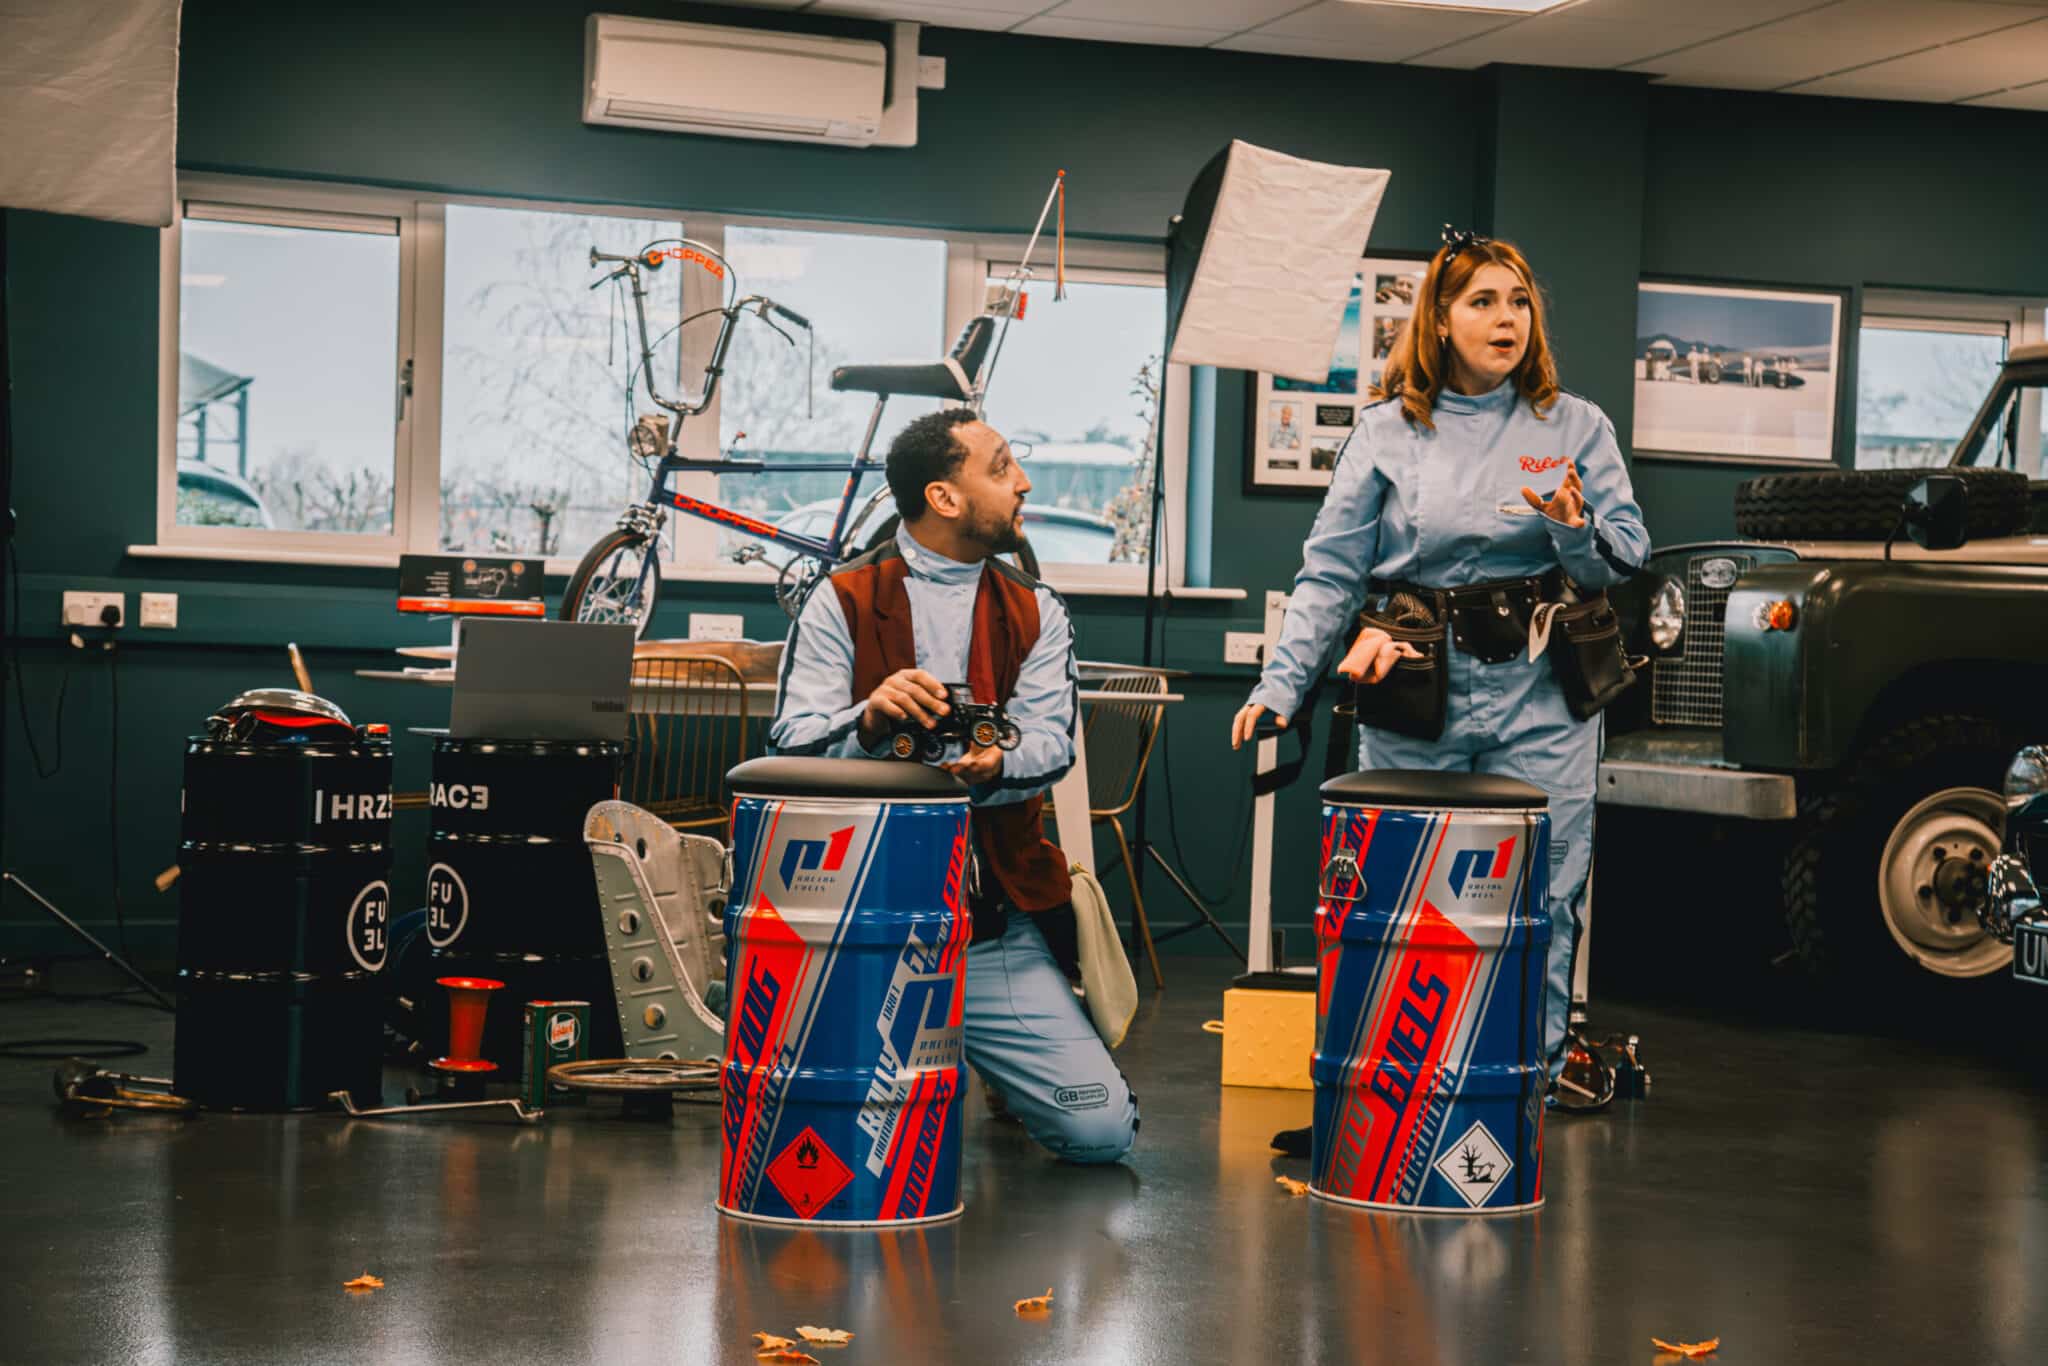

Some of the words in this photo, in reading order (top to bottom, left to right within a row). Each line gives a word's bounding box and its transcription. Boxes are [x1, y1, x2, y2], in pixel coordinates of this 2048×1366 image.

[673, 493, 778, 539] CHOPPER
[431, 881, 453, 905] FU
[364, 901, 386, 924] FU
[1370, 959, 1451, 1119] FUELS
[1059, 1089, 1079, 1103] GB
